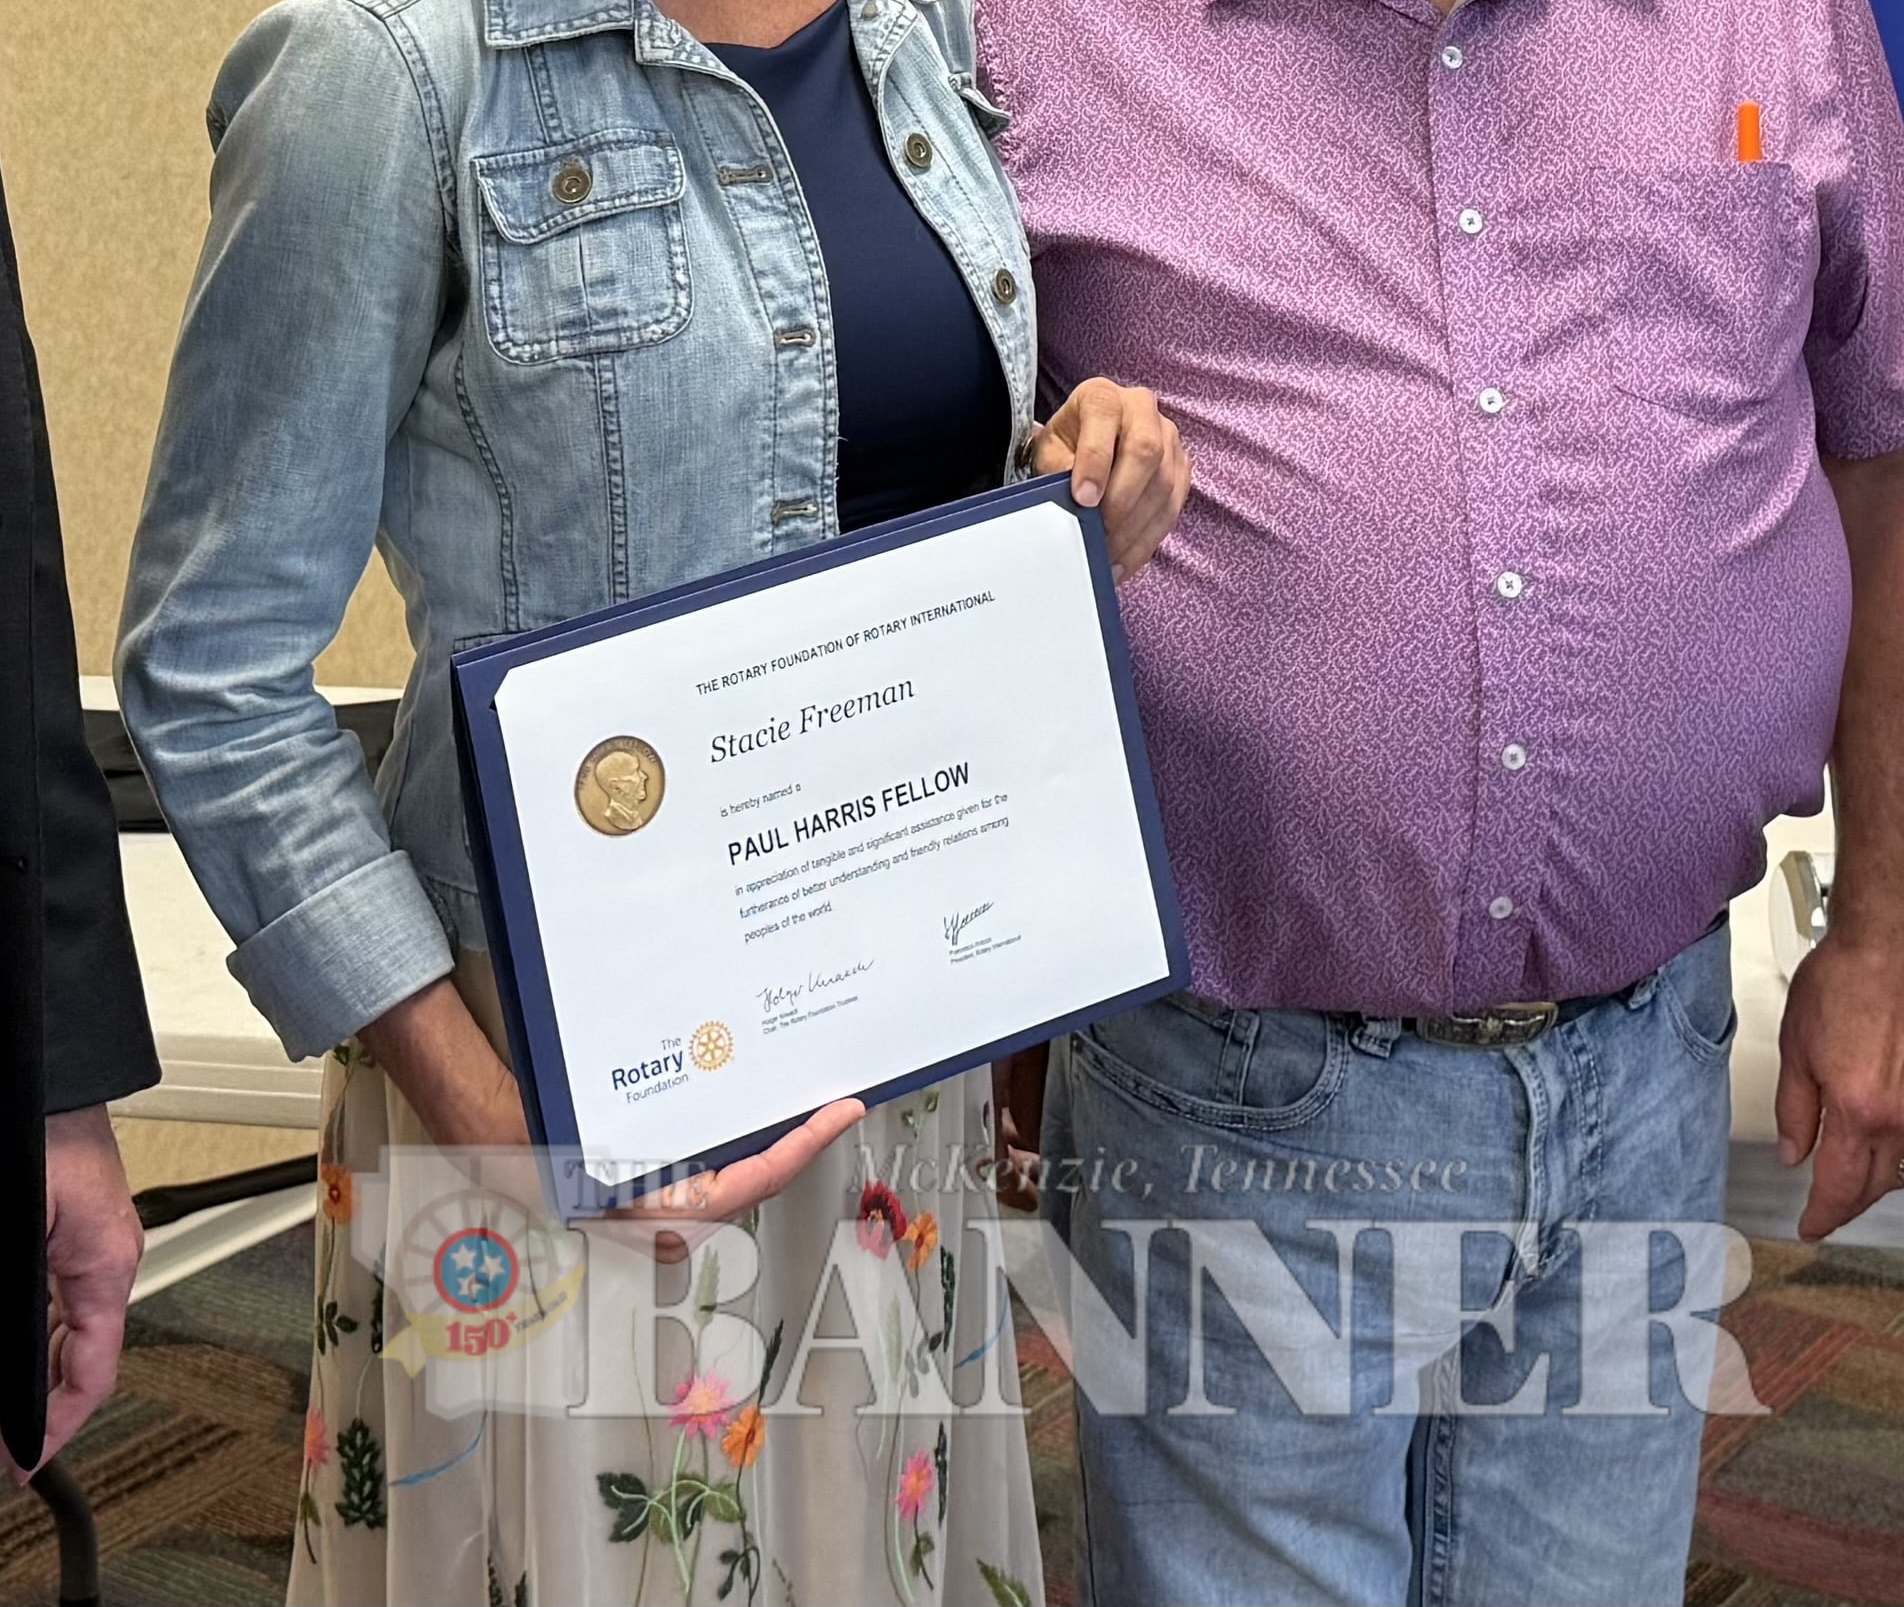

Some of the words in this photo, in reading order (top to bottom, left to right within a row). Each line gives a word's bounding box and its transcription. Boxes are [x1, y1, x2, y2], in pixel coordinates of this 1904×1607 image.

[696, 678, 720, 696] THE
[721, 662, 769, 689] ROTARY
[770, 640, 844, 673] FOUNDATION
[845, 632, 861, 649] OF
[863, 617, 908, 644] ROTARY
[909, 589, 997, 627] INTERNATIONAL
[710, 716, 791, 764] Stacie
[798, 679, 916, 736] Freeman
[719, 807, 729, 818] is
[729, 796, 760, 814] hereby
[762, 783, 793, 803] named
[795, 783, 802, 792] a
[727, 827, 789, 866] PAUL
[793, 795, 876, 843] HARRIS
[881, 761, 970, 813] FELLOW
[735, 885, 744, 896] in
[746, 866, 800, 894] appreciation
[800, 860, 810, 873] of
[811, 848, 846, 867] tangible
[847, 842, 865, 857] and
[865, 825, 910, 851] significant
[910, 811, 956, 835] assistance
[956, 803, 980, 821] given
[980, 797, 993, 809] for
[739, 894, 790, 919] furtherance
[791, 887, 800, 901] of
[801, 880, 828, 897] better
[829, 857, 891, 888] understanding
[892, 851, 909, 865] and
[909, 839, 942, 858] friendly
[942, 827, 979, 846] relations
[979, 816, 1010, 834] among
[744, 922, 780, 945] peoples
[780, 916, 790, 929] of
[791, 913, 806, 925] the
[611, 1050, 684, 1091] Rotary
[661, 1037, 681, 1051] The
[625, 1073, 689, 1104] Foundation
